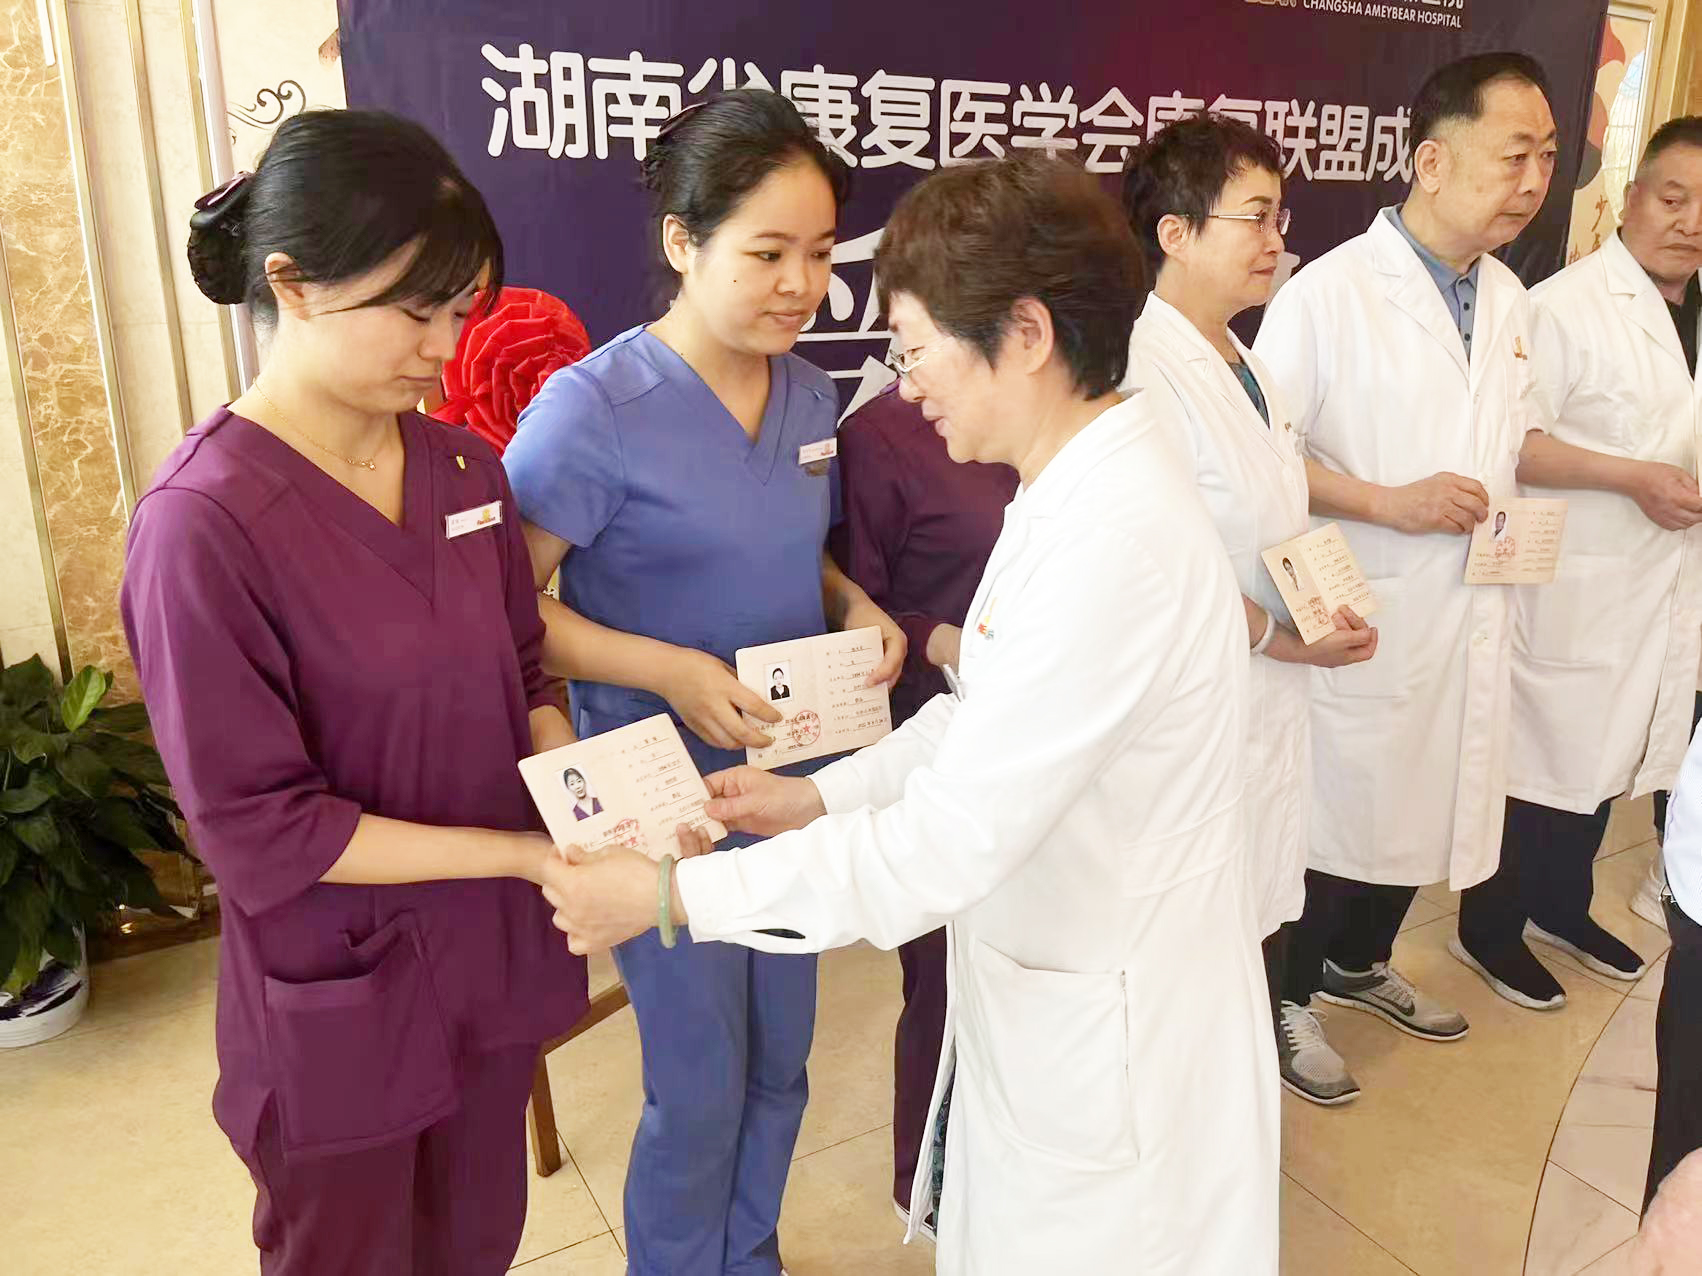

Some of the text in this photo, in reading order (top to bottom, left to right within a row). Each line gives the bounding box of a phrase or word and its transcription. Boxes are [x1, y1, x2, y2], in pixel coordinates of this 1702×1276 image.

[1303, 0, 1362, 15] CHANGSHA
[1364, 3, 1416, 22] AMEYBEAR
[1417, 10, 1462, 28] HOSPITAL
